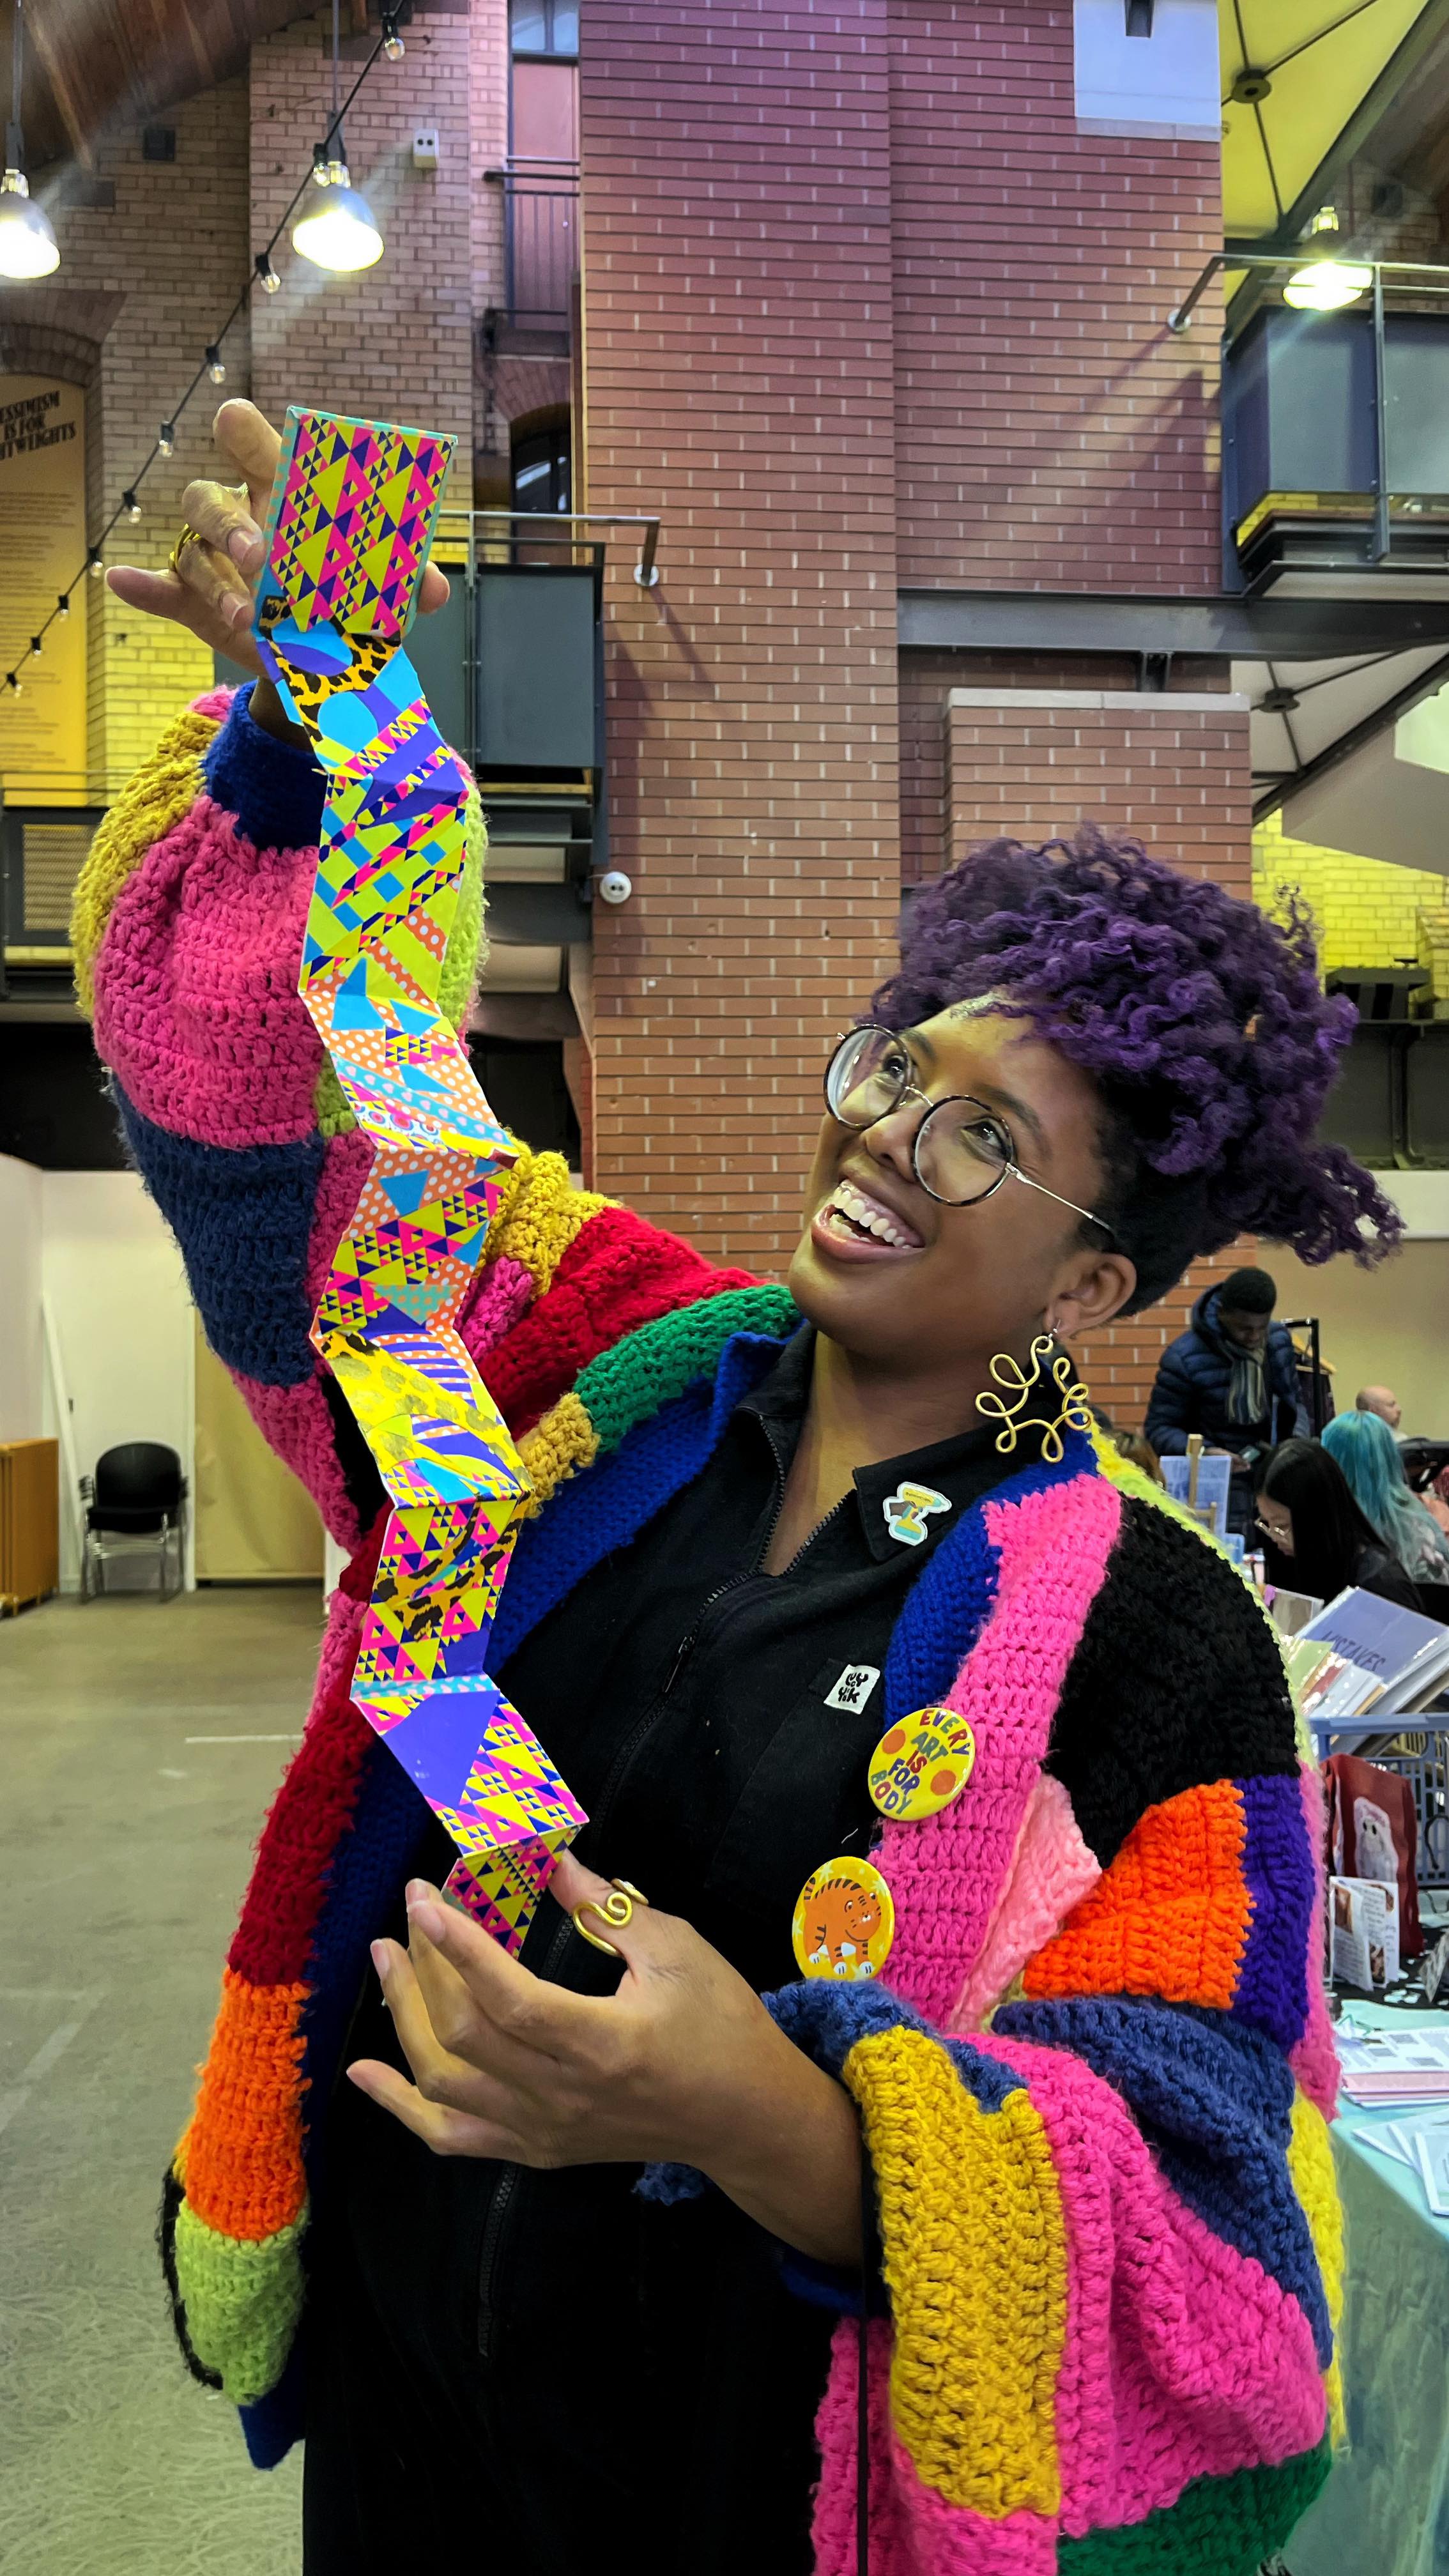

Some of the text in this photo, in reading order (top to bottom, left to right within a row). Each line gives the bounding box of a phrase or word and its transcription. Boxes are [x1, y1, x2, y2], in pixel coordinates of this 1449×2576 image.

[911, 1731, 949, 1762] ART
[919, 1709, 970, 1755] EVERY
[887, 1758, 920, 1795] FOR
[906, 1750, 928, 1774] IS
[871, 1770, 912, 1814] BODY
